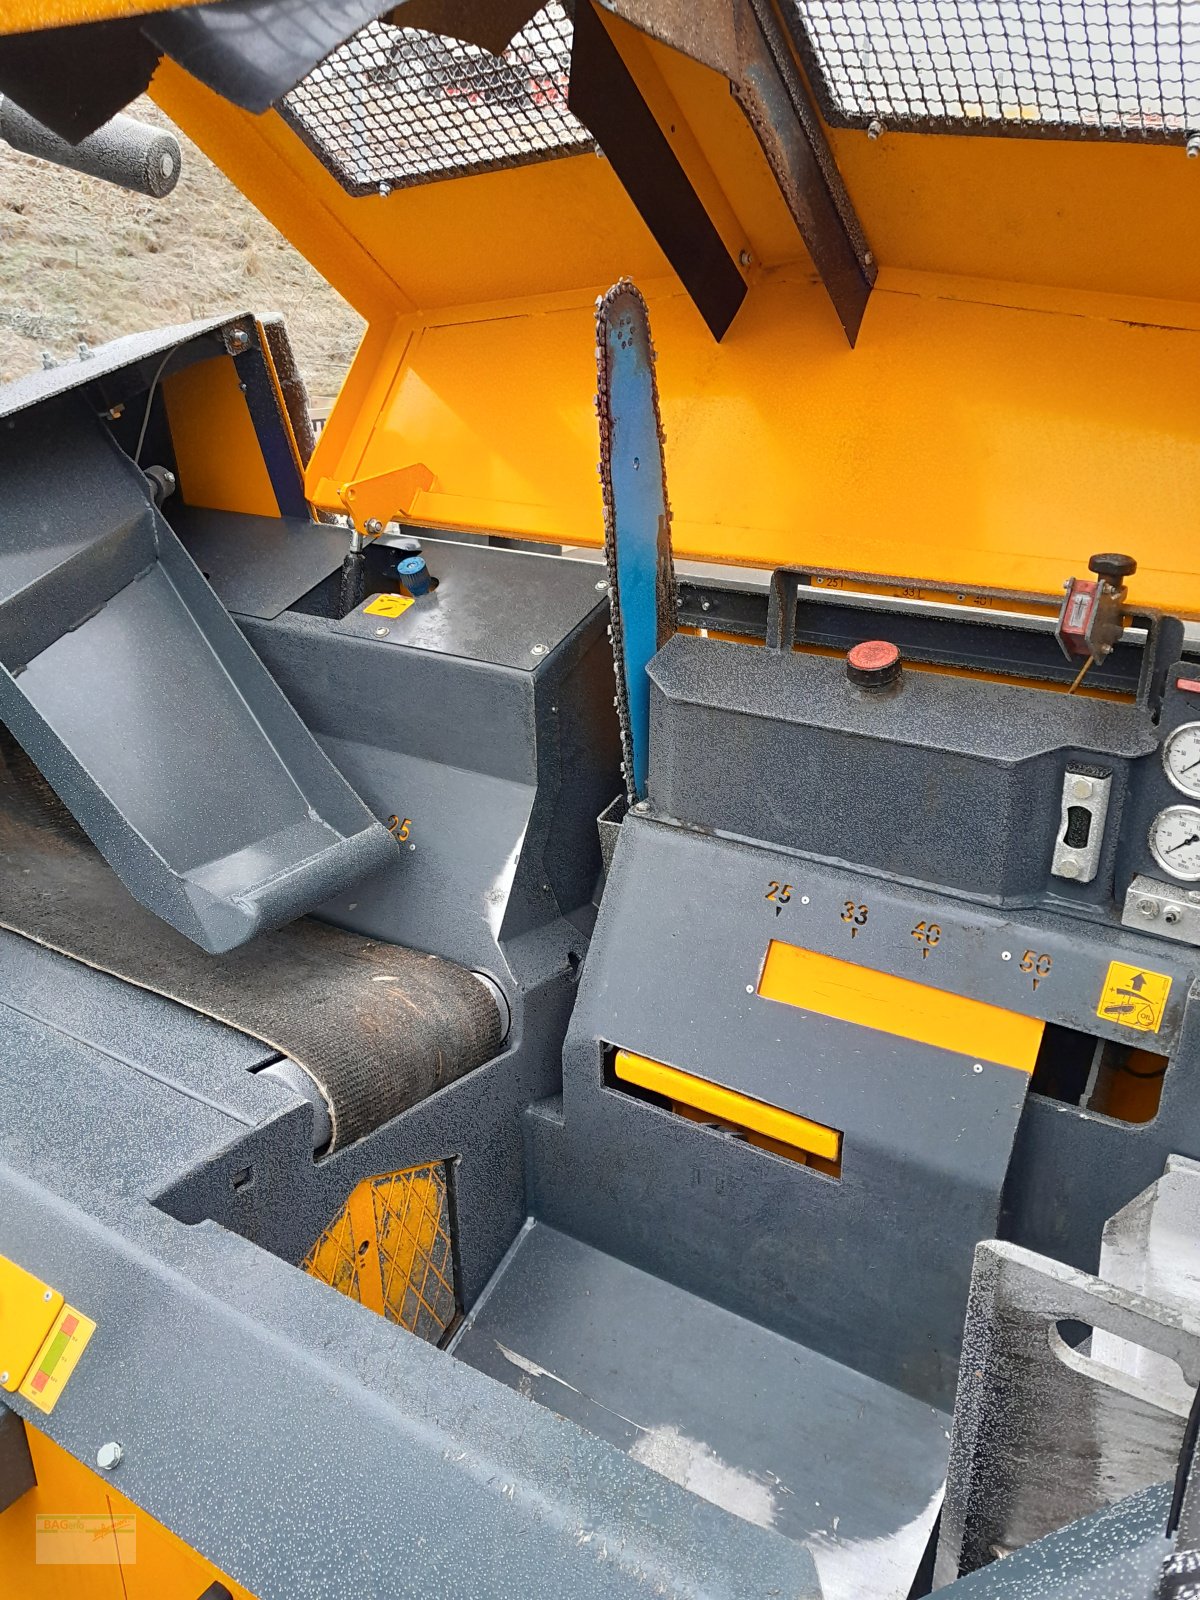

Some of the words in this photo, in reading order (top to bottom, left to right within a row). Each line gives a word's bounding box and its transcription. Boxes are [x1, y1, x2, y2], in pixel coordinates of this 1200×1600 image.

[387, 814, 412, 842] 25
[764, 881, 793, 904] 25
[840, 901, 869, 926] 33
[910, 920, 942, 947] 40
[1018, 950, 1053, 977] 50
[1140, 1012, 1153, 1022] OIL
